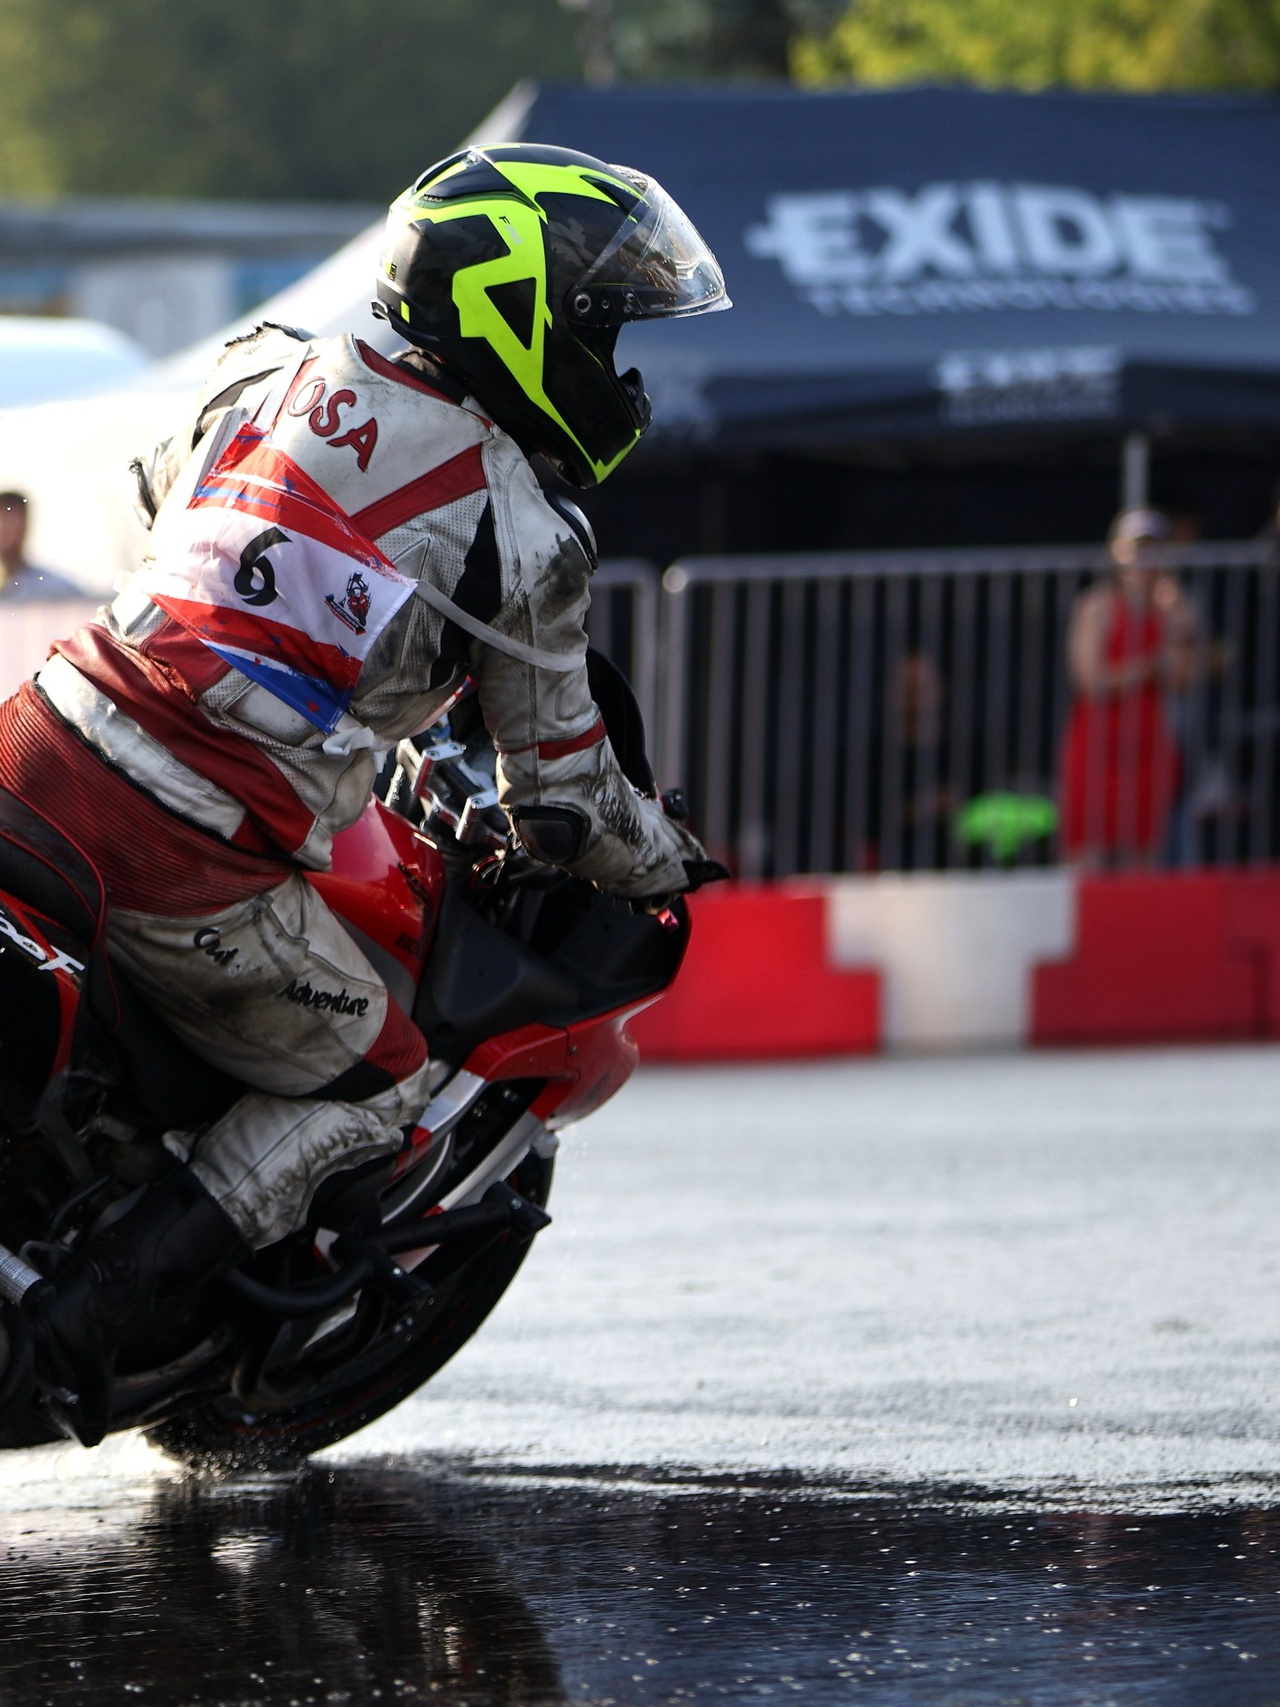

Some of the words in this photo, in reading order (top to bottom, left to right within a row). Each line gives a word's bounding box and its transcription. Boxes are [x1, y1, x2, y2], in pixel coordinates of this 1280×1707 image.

[748, 180, 1232, 289] EXIDE
[814, 282, 1256, 317] TECHNOLOGIES
[233, 526, 292, 607] 6
[281, 978, 370, 1018] Adventure
